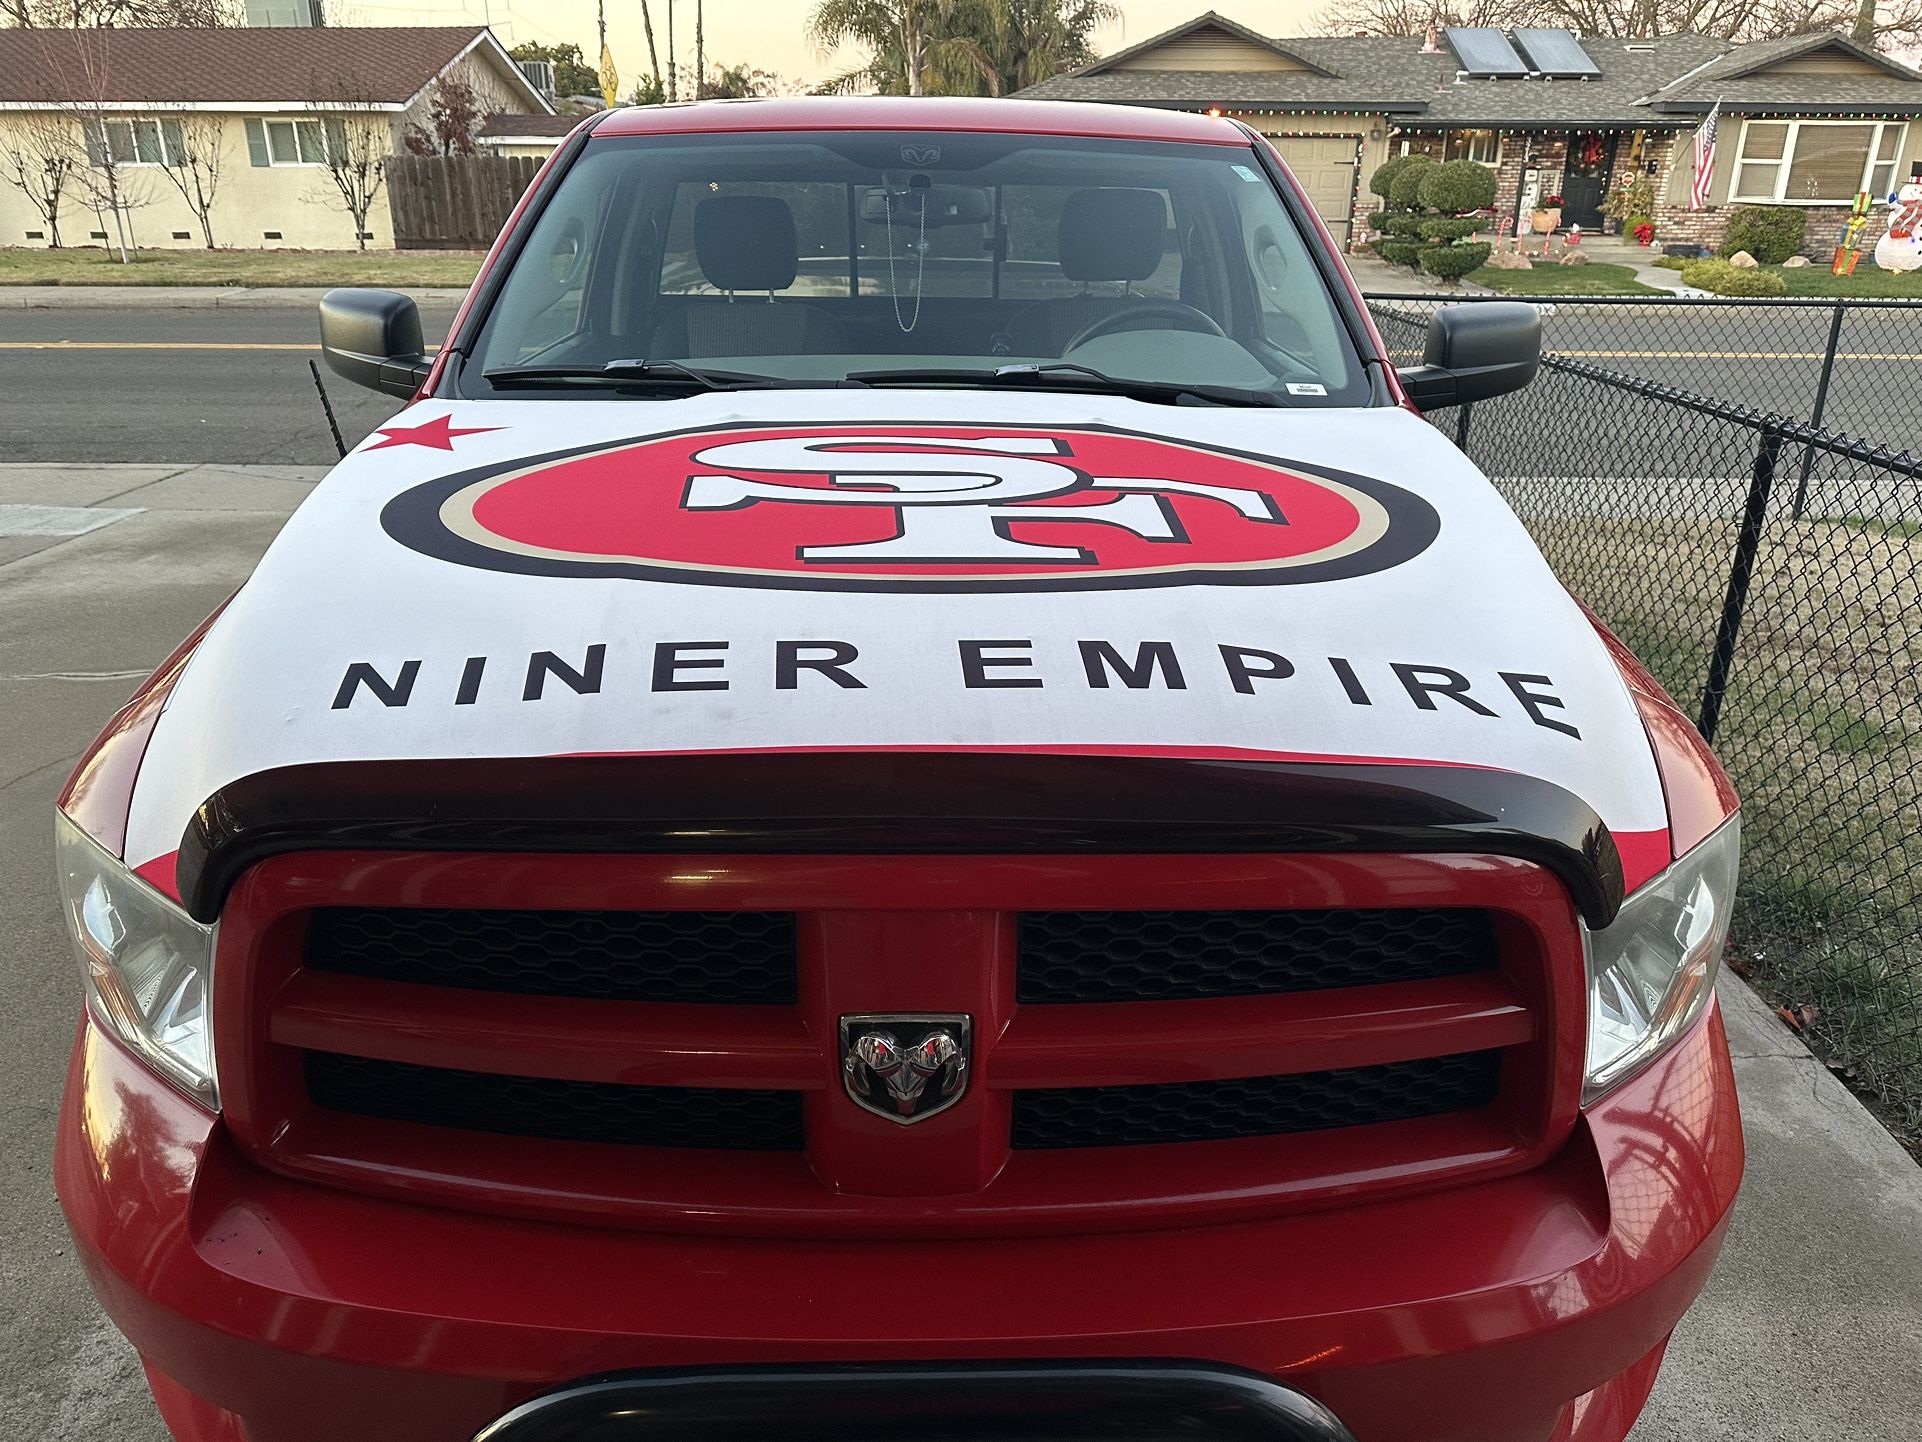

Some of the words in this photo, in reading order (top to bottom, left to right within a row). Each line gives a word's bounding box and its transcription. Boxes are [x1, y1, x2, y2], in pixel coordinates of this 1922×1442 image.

[679, 436, 1290, 566] SF
[331, 640, 868, 709] NINER
[958, 639, 1583, 740] EMPIRE
